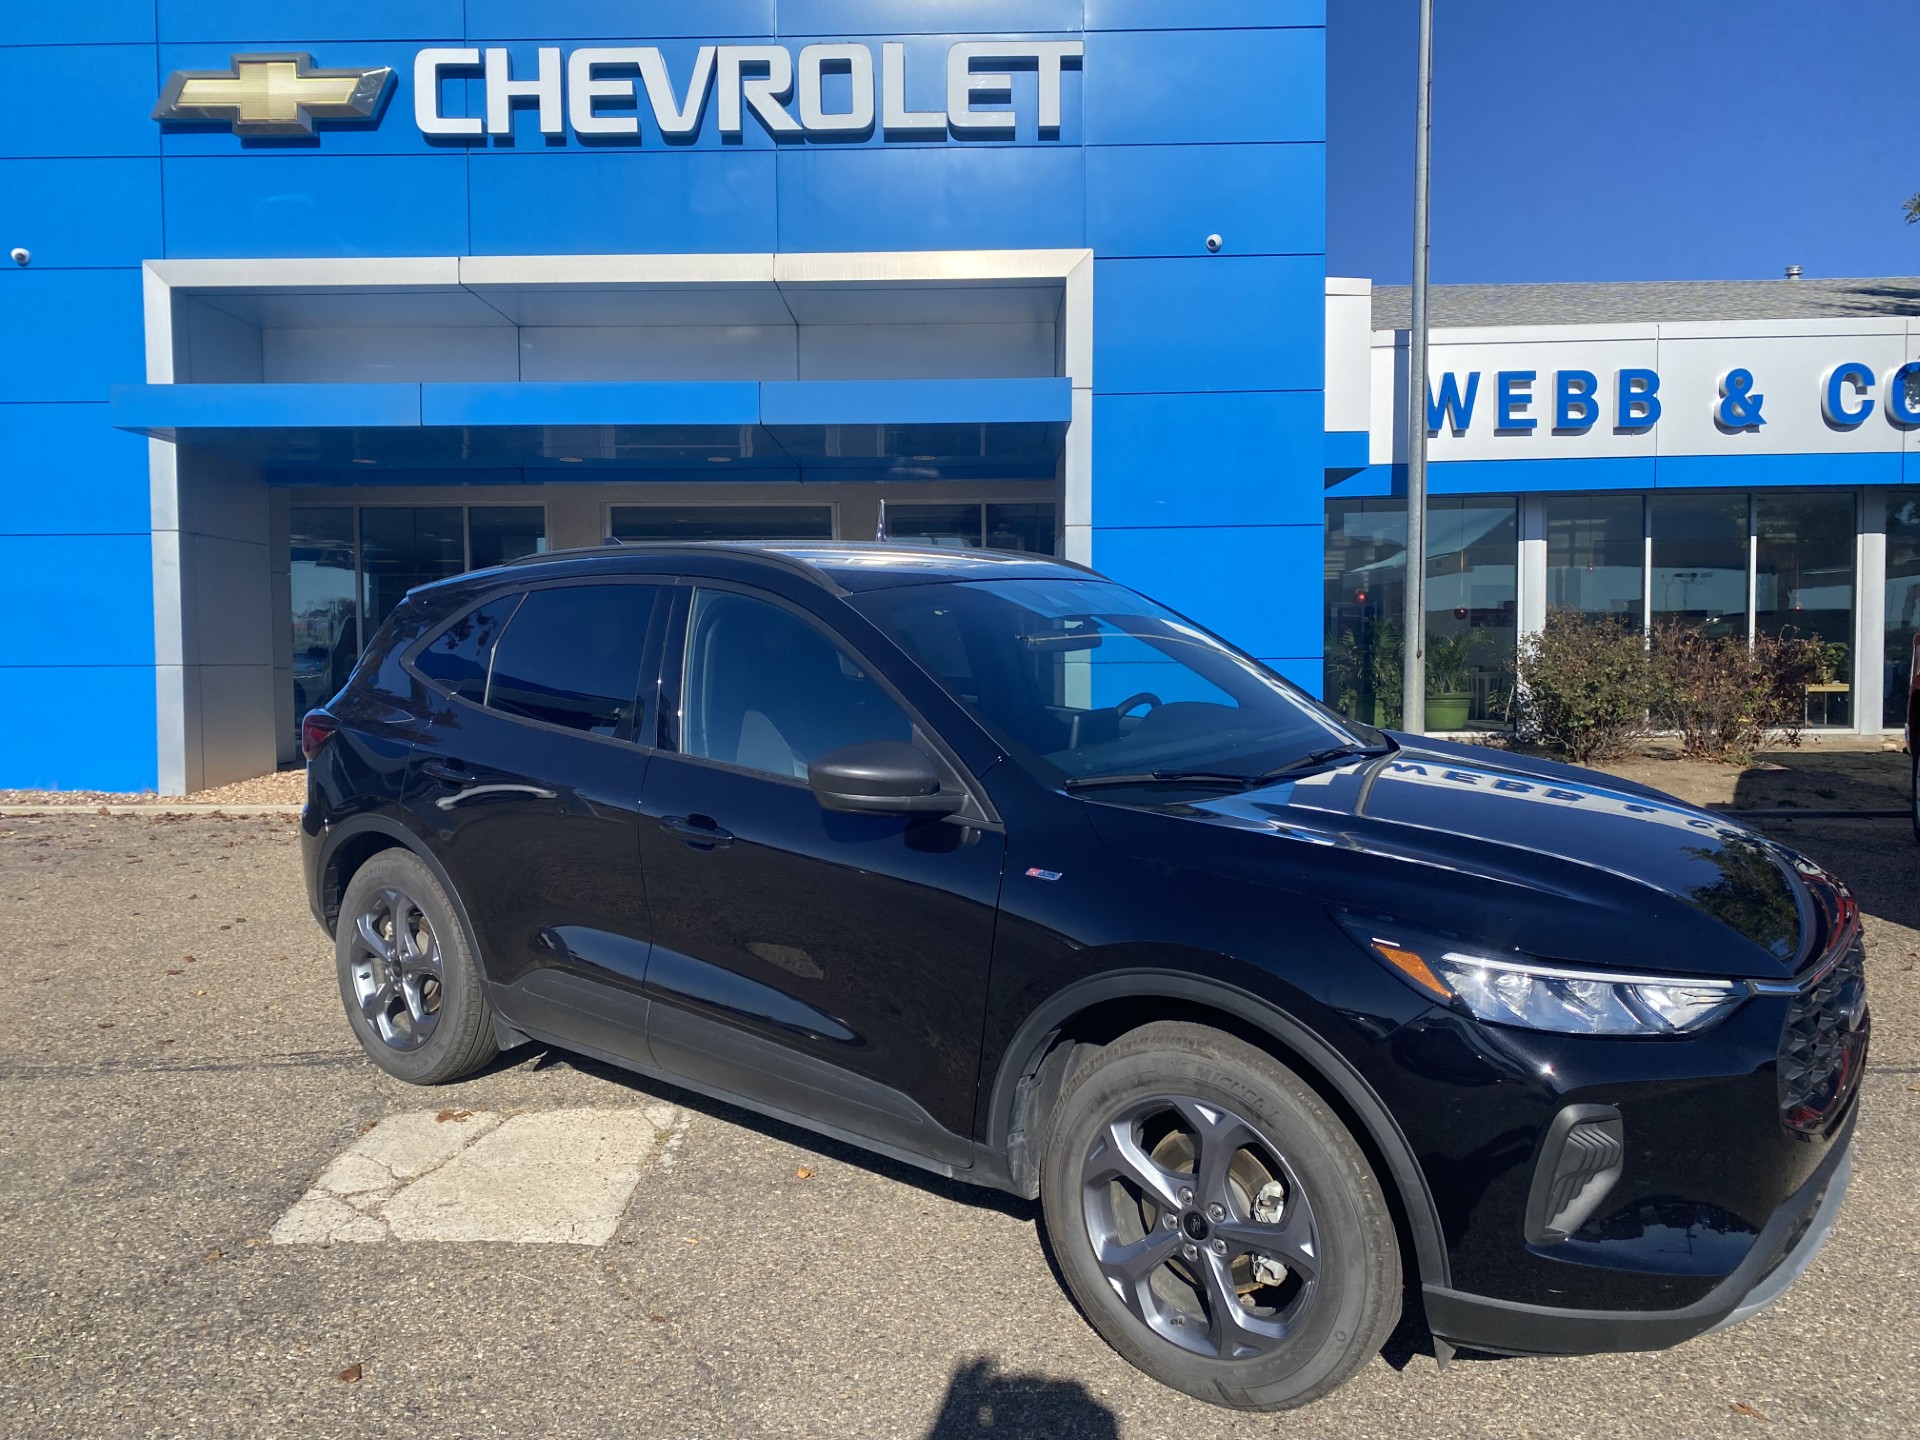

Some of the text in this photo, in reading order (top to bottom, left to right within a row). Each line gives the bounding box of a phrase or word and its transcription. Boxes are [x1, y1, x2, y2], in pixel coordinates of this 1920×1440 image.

[413, 41, 1084, 136] CHEVROLET
[1427, 368, 1661, 430] WEBB
[1718, 368, 1767, 428] &
